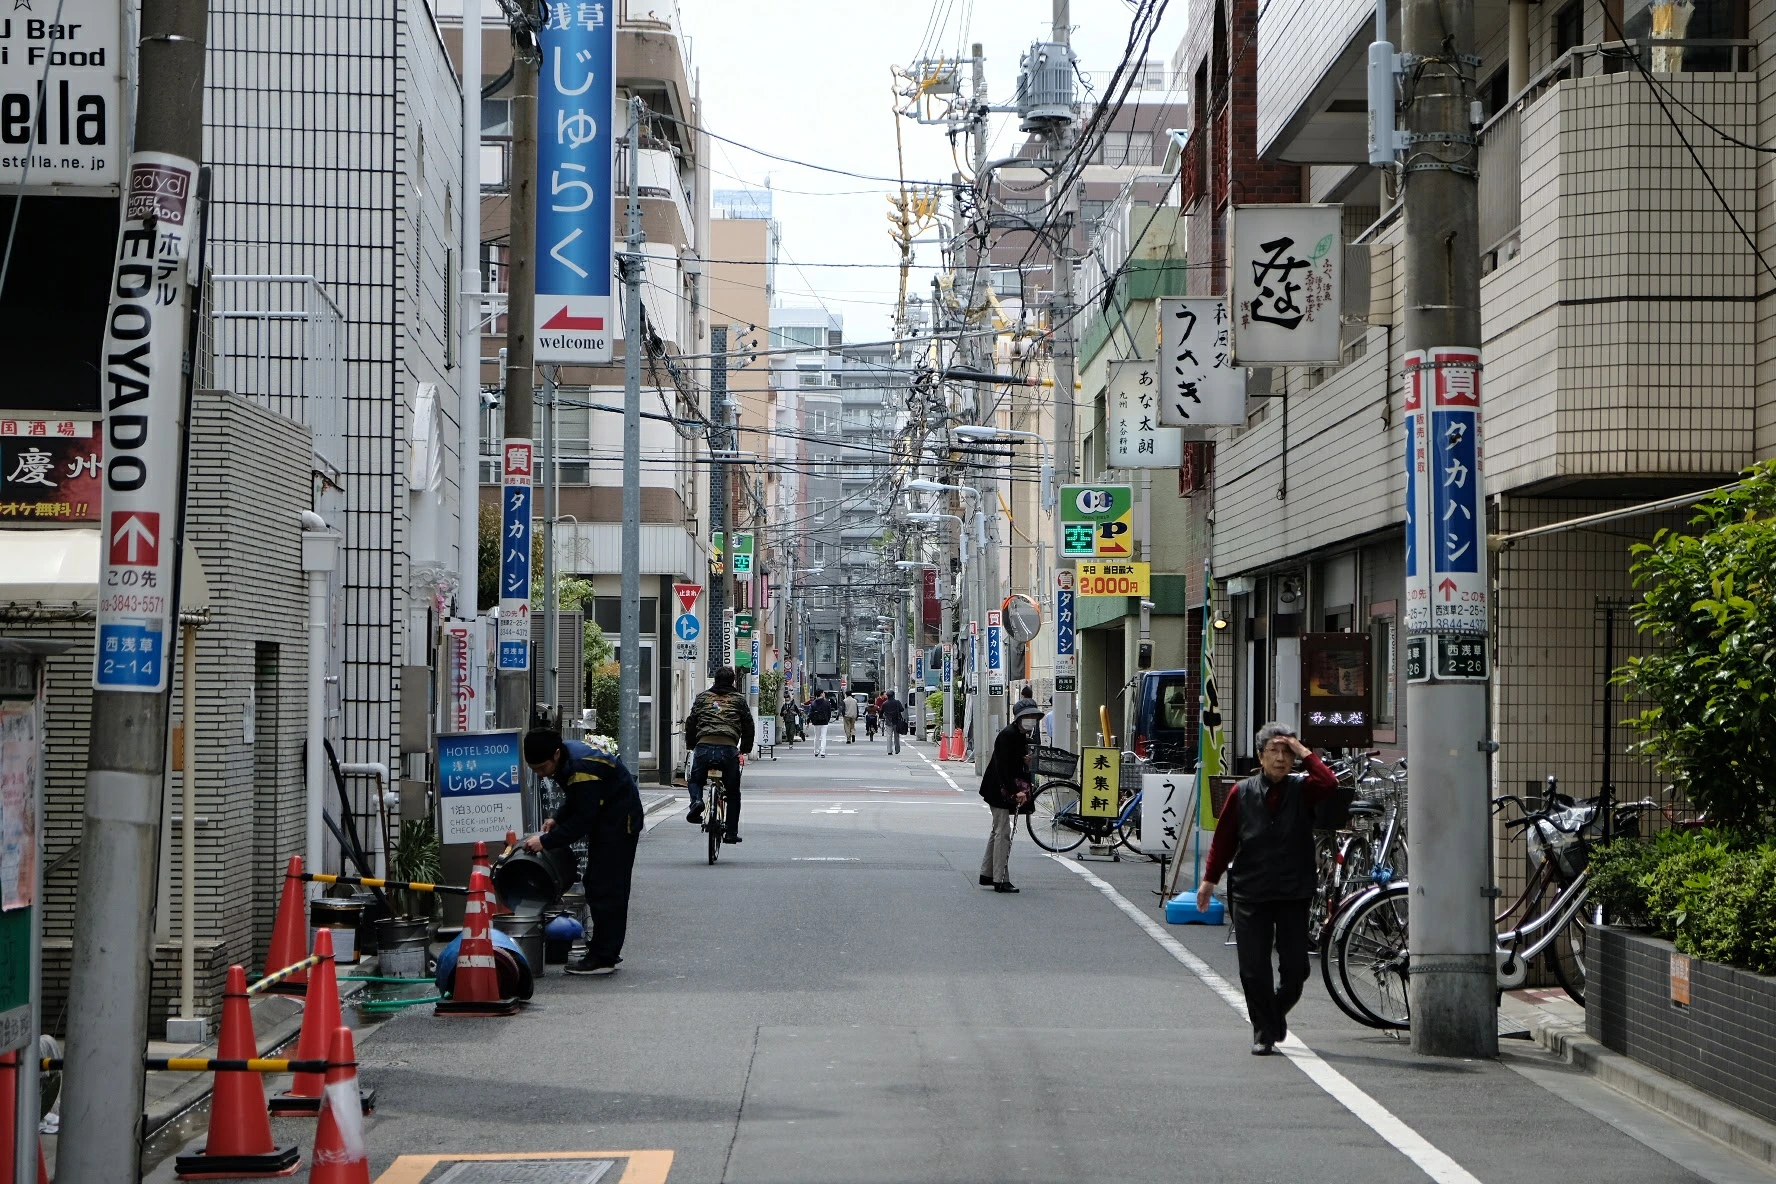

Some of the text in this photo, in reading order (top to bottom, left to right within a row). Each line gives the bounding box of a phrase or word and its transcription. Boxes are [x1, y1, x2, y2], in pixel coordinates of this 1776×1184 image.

[27, 19, 82, 40] Bar
[28, 47, 105, 66] Food
[1, 80, 106, 145] ella
[550, 46, 597, 280] じゅらく
[133, 170, 183, 195] edyd
[129, 196, 161, 207] HOTEL
[155, 232, 182, 306] ホテル
[1240, 301, 1250, 330] 浅草
[539, 335, 605, 351] welcome
[108, 228, 157, 492] EDOYADO
[1175, 304, 1206, 419] うさぎ
[1119, 392, 1128, 409] 九州
[1, 420, 76, 436] 国酒場
[1416, 414, 1426, 473] 販売・買取
[6, 447, 102, 487] 慶州
[1443, 420, 1472, 562] タカハシ
[0, 502, 88, 518] オケ無料!!
[1065, 525, 1094, 554] 空
[1100, 522, 1128, 538] P
[506, 492, 525, 592] タカハシ
[106, 570, 158, 588] この先
[1082, 566, 1134, 574] 平日 当日最大
[1080, 577, 1138, 595] 2,000円
[1460, 591, 1485, 602] この先
[500, 610, 518, 618] この先
[1058, 592, 1073, 654] タカハシ
[105, 635, 154, 654] 西浅草
[990, 629, 998, 667] タカハシ
[1447, 644, 1482, 656] 西浅草
[103, 660, 152, 675] 2-14
[1448, 660, 1482, 672] 2-26
[446, 744, 510, 757] HOTEL 3000
[452, 760, 478, 772] 浅草
[448, 772, 510, 792] じゅらく
